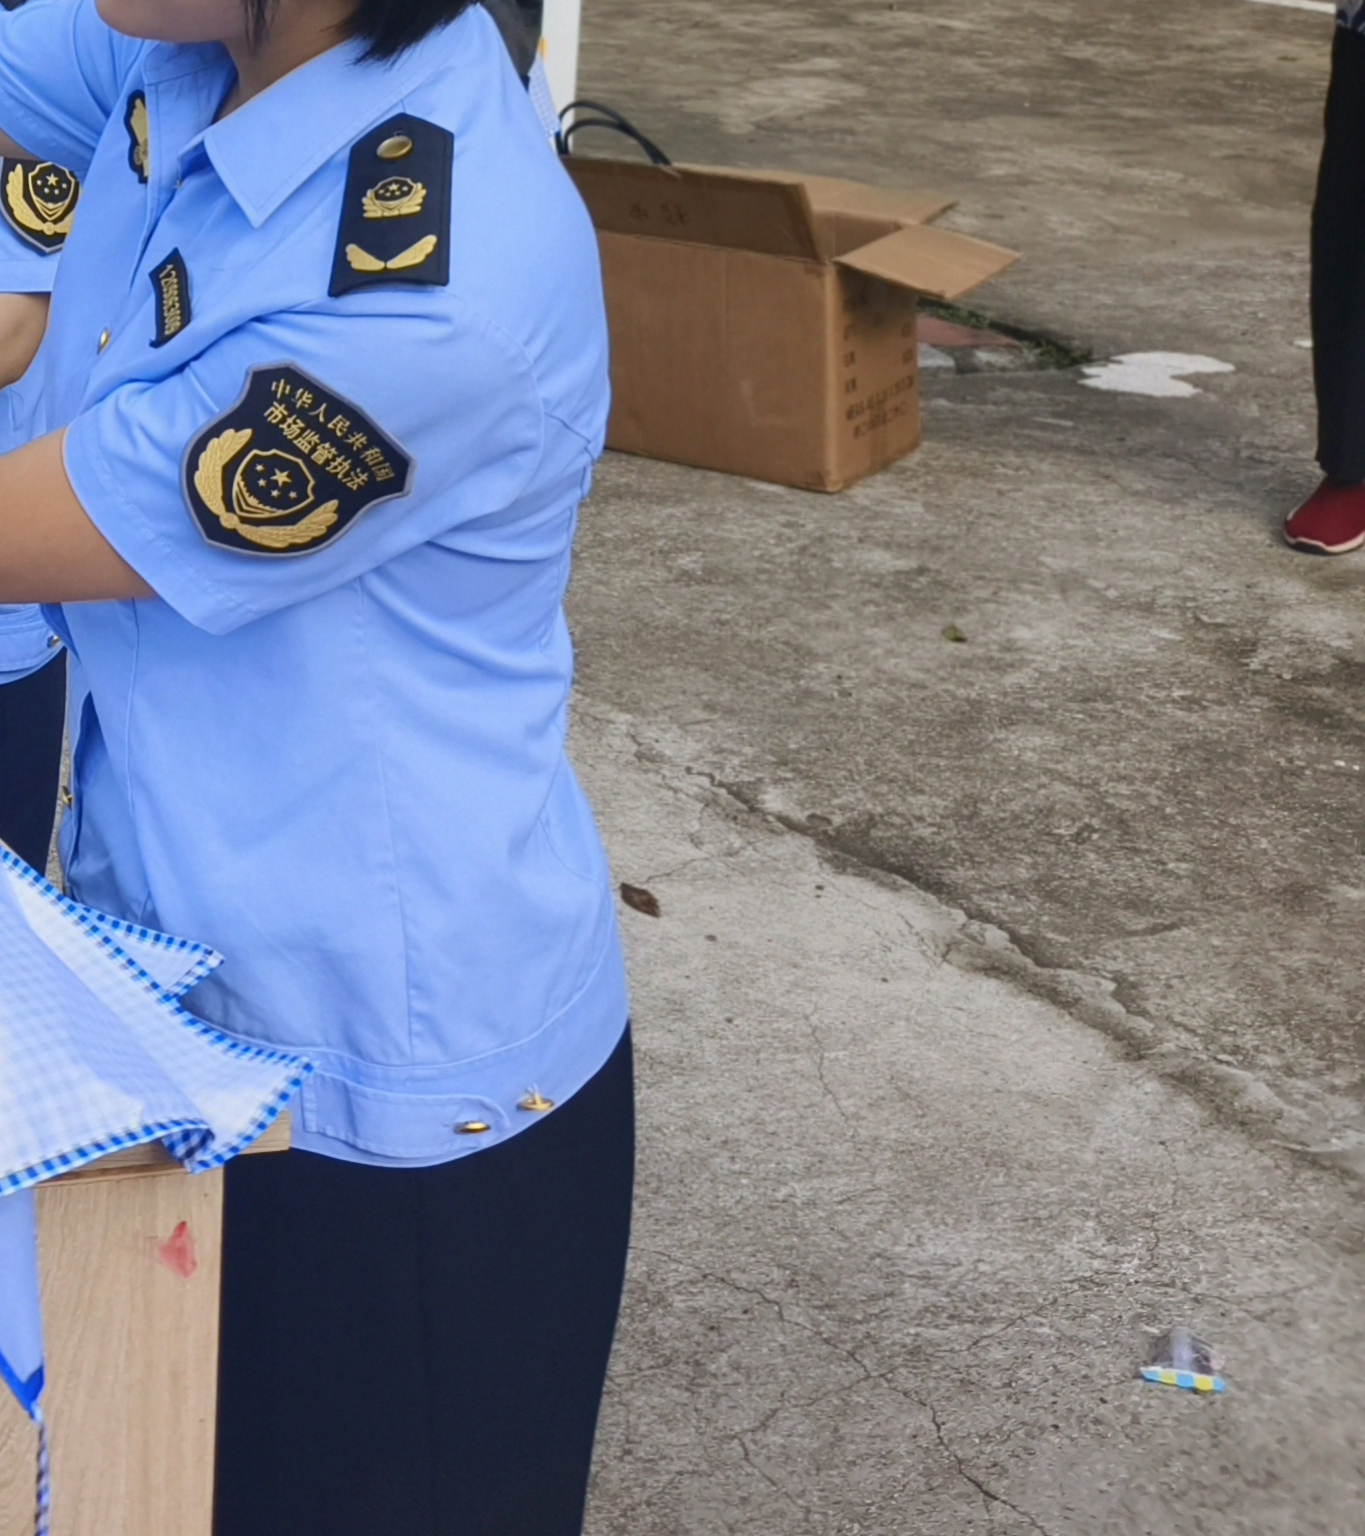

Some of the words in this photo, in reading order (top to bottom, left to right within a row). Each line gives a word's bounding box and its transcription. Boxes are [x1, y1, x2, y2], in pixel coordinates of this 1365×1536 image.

[263, 401, 371, 492] 市场监管执法
[270, 378, 395, 483] 中华人民共和国
